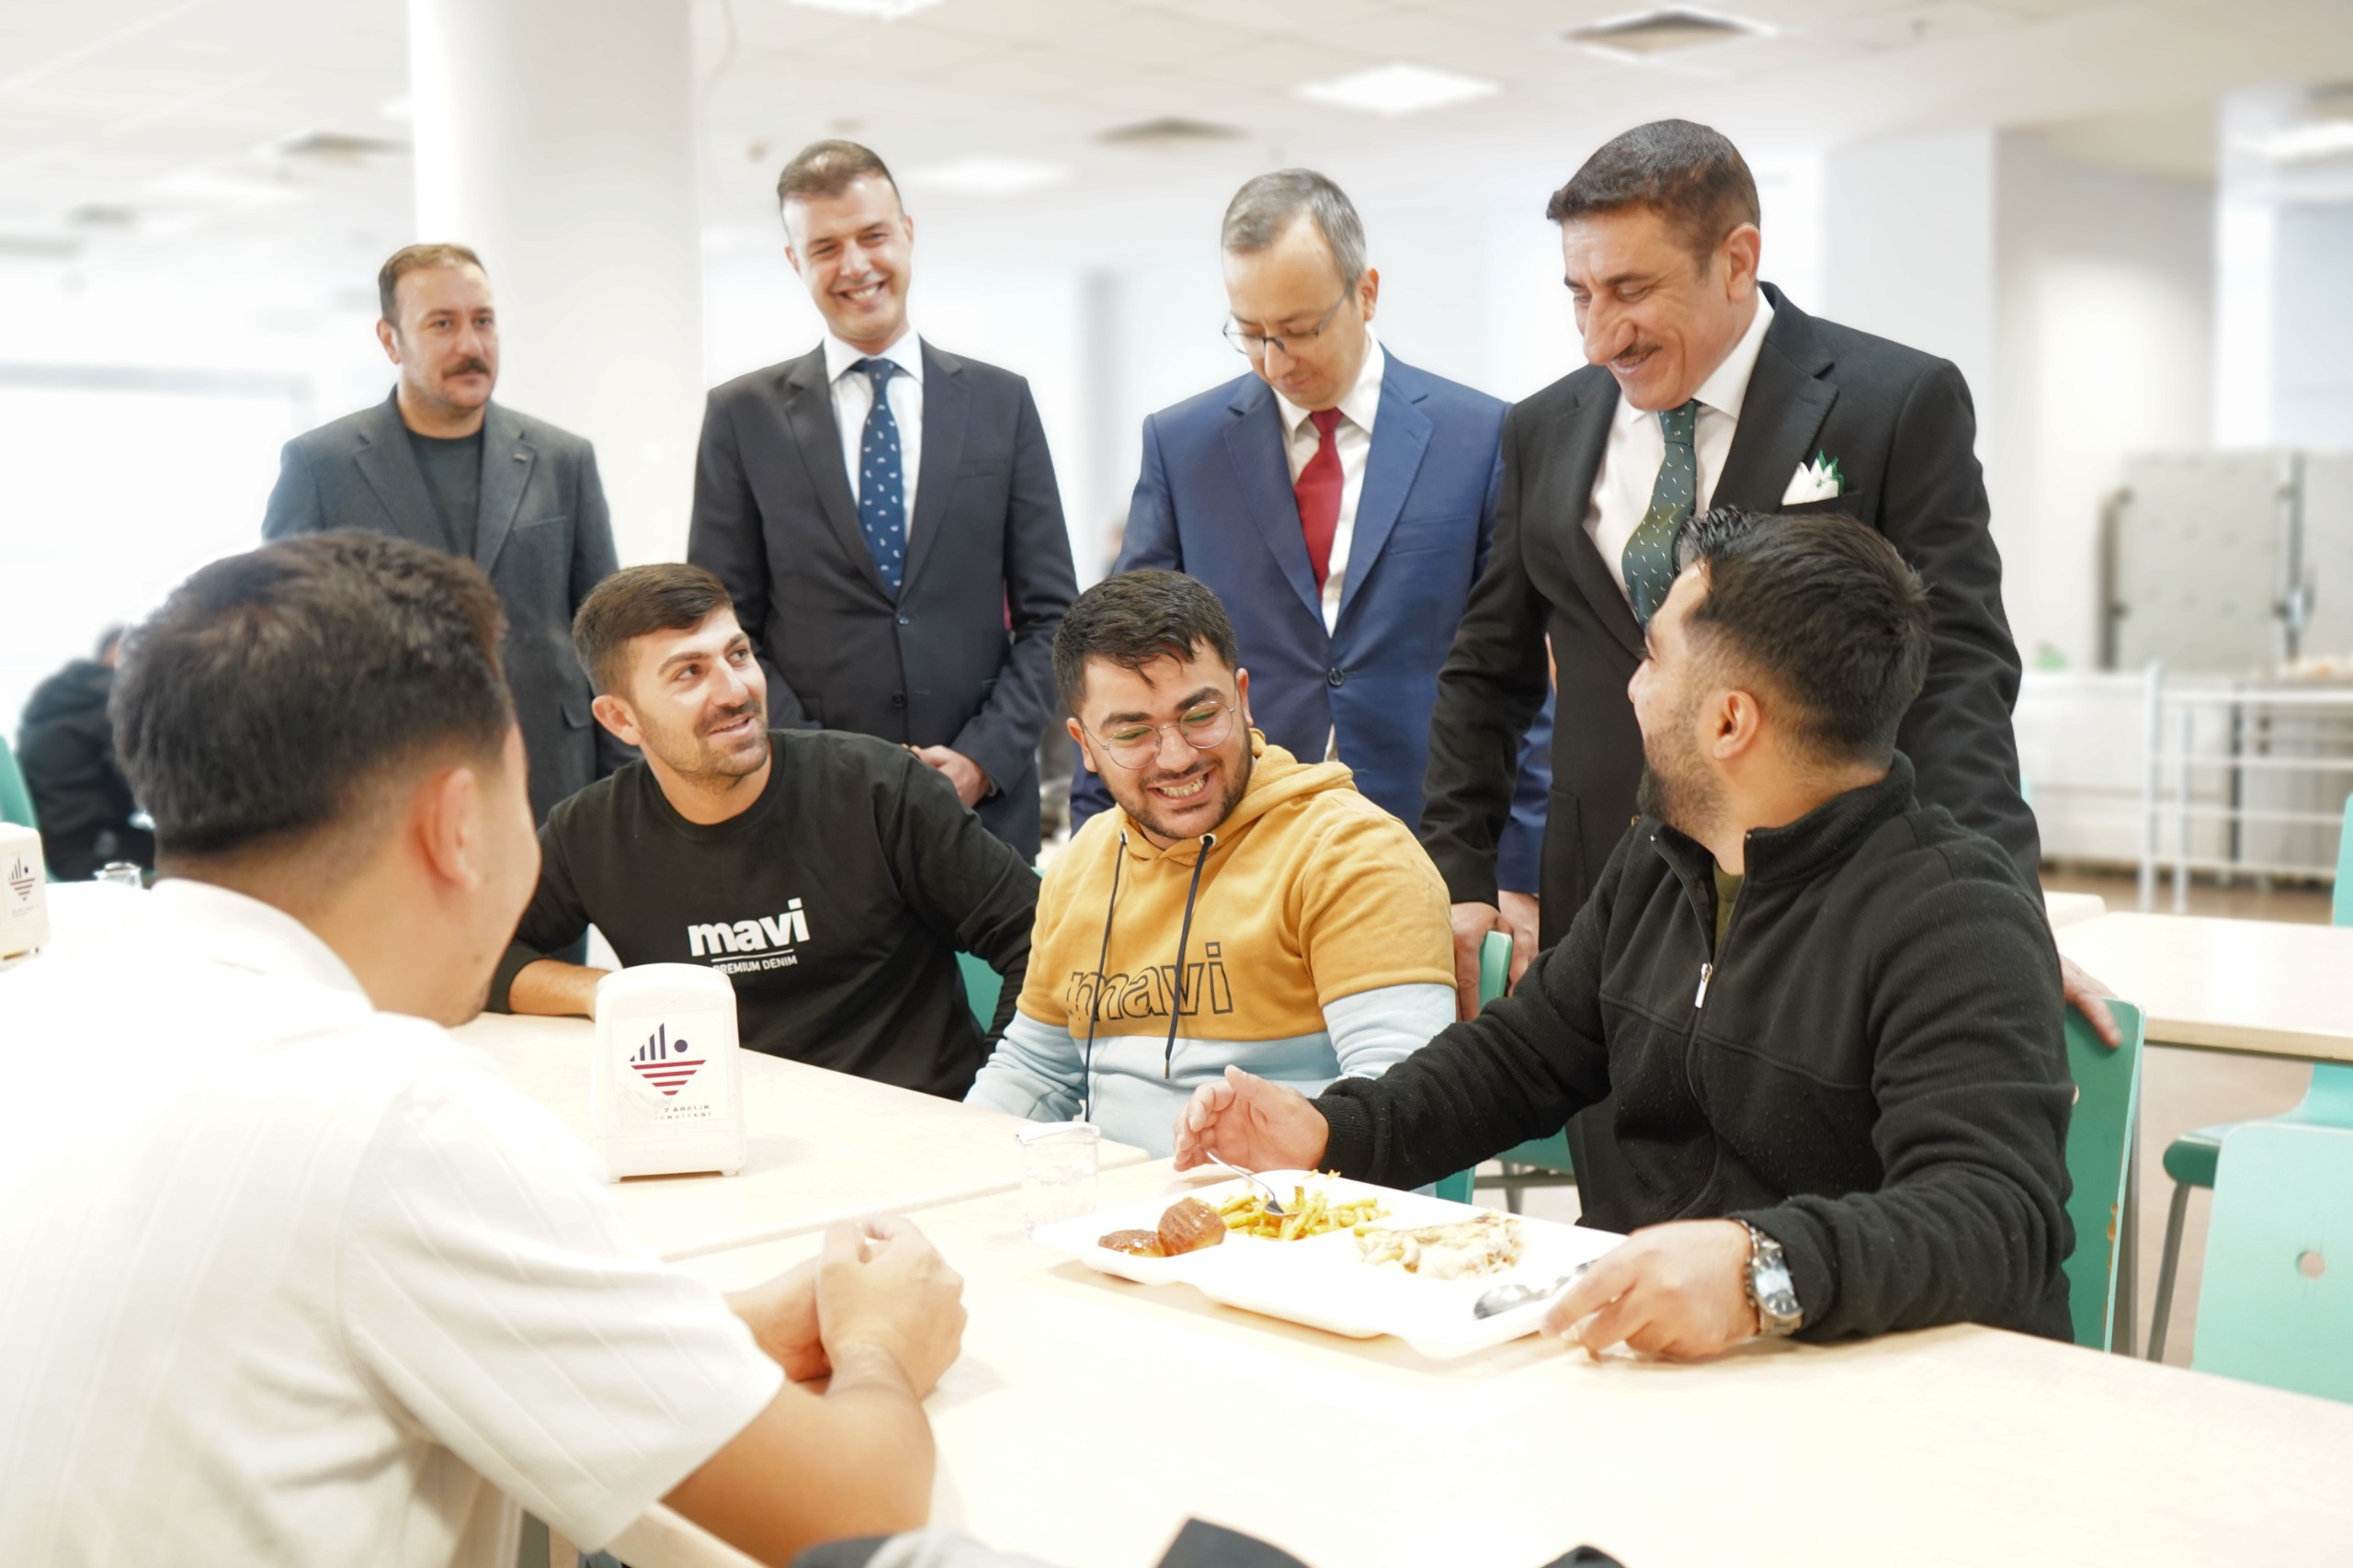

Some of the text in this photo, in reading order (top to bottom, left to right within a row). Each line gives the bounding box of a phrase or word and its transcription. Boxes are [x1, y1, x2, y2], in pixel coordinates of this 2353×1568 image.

[688, 897, 811, 957] mavi
[761, 955, 798, 970] DENIM
[1066, 941, 1233, 1022] mavi
